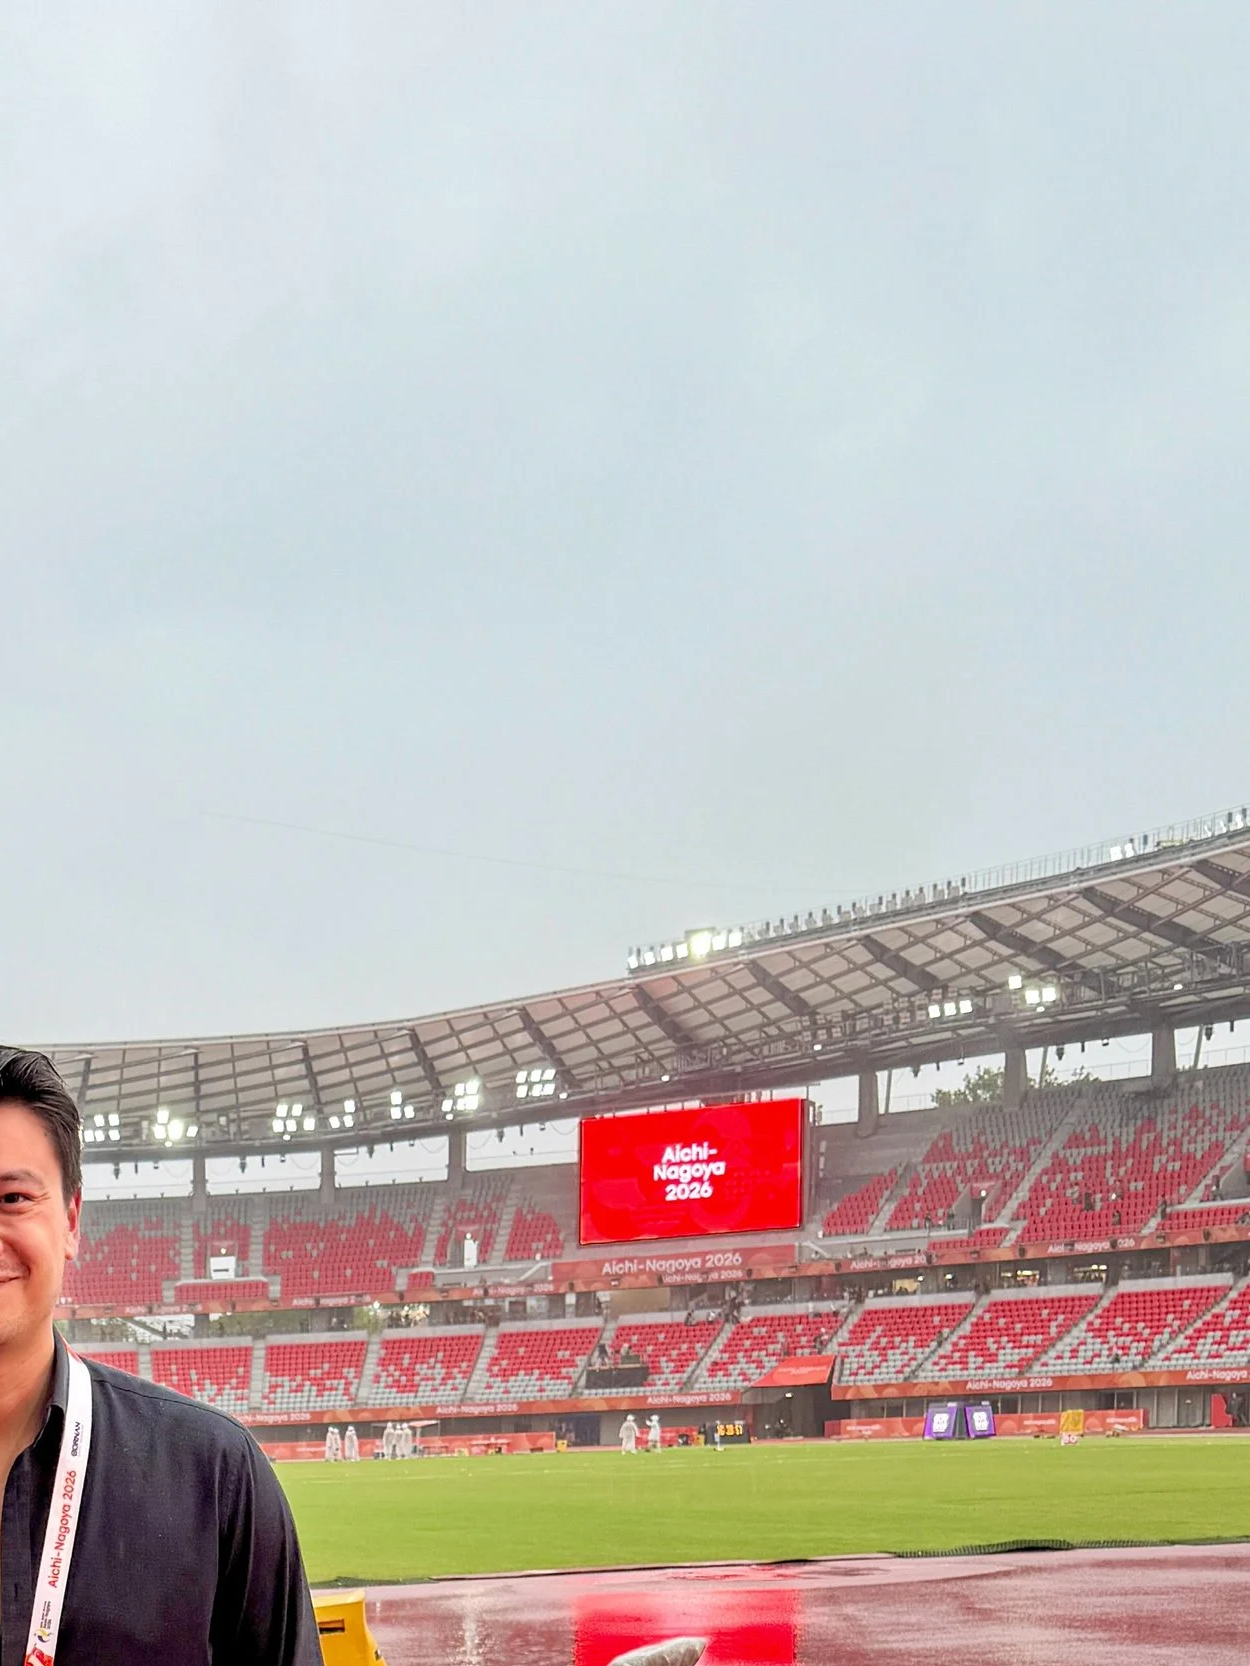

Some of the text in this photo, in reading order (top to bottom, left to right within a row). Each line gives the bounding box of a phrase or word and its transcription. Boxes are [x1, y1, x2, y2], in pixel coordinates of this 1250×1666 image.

[661, 1141, 718, 1164] Aichi-
[653, 1161, 726, 1183] Nagoya
[665, 1182, 713, 1201] 2026
[602, 1252, 743, 1275] Aichi-Nagoya 2026
[966, 1378, 1052, 1391] Aichi-Nagoya 2026
[1186, 1369, 1248, 1382] Aichi-Nagoya
[647, 1393, 732, 1405] Aichi-Nagoya 2026
[436, 1403, 518, 1416] Aichi-Nagoya 2026
[48, 1470, 77, 1588] Aichi-Nagoya 2026
